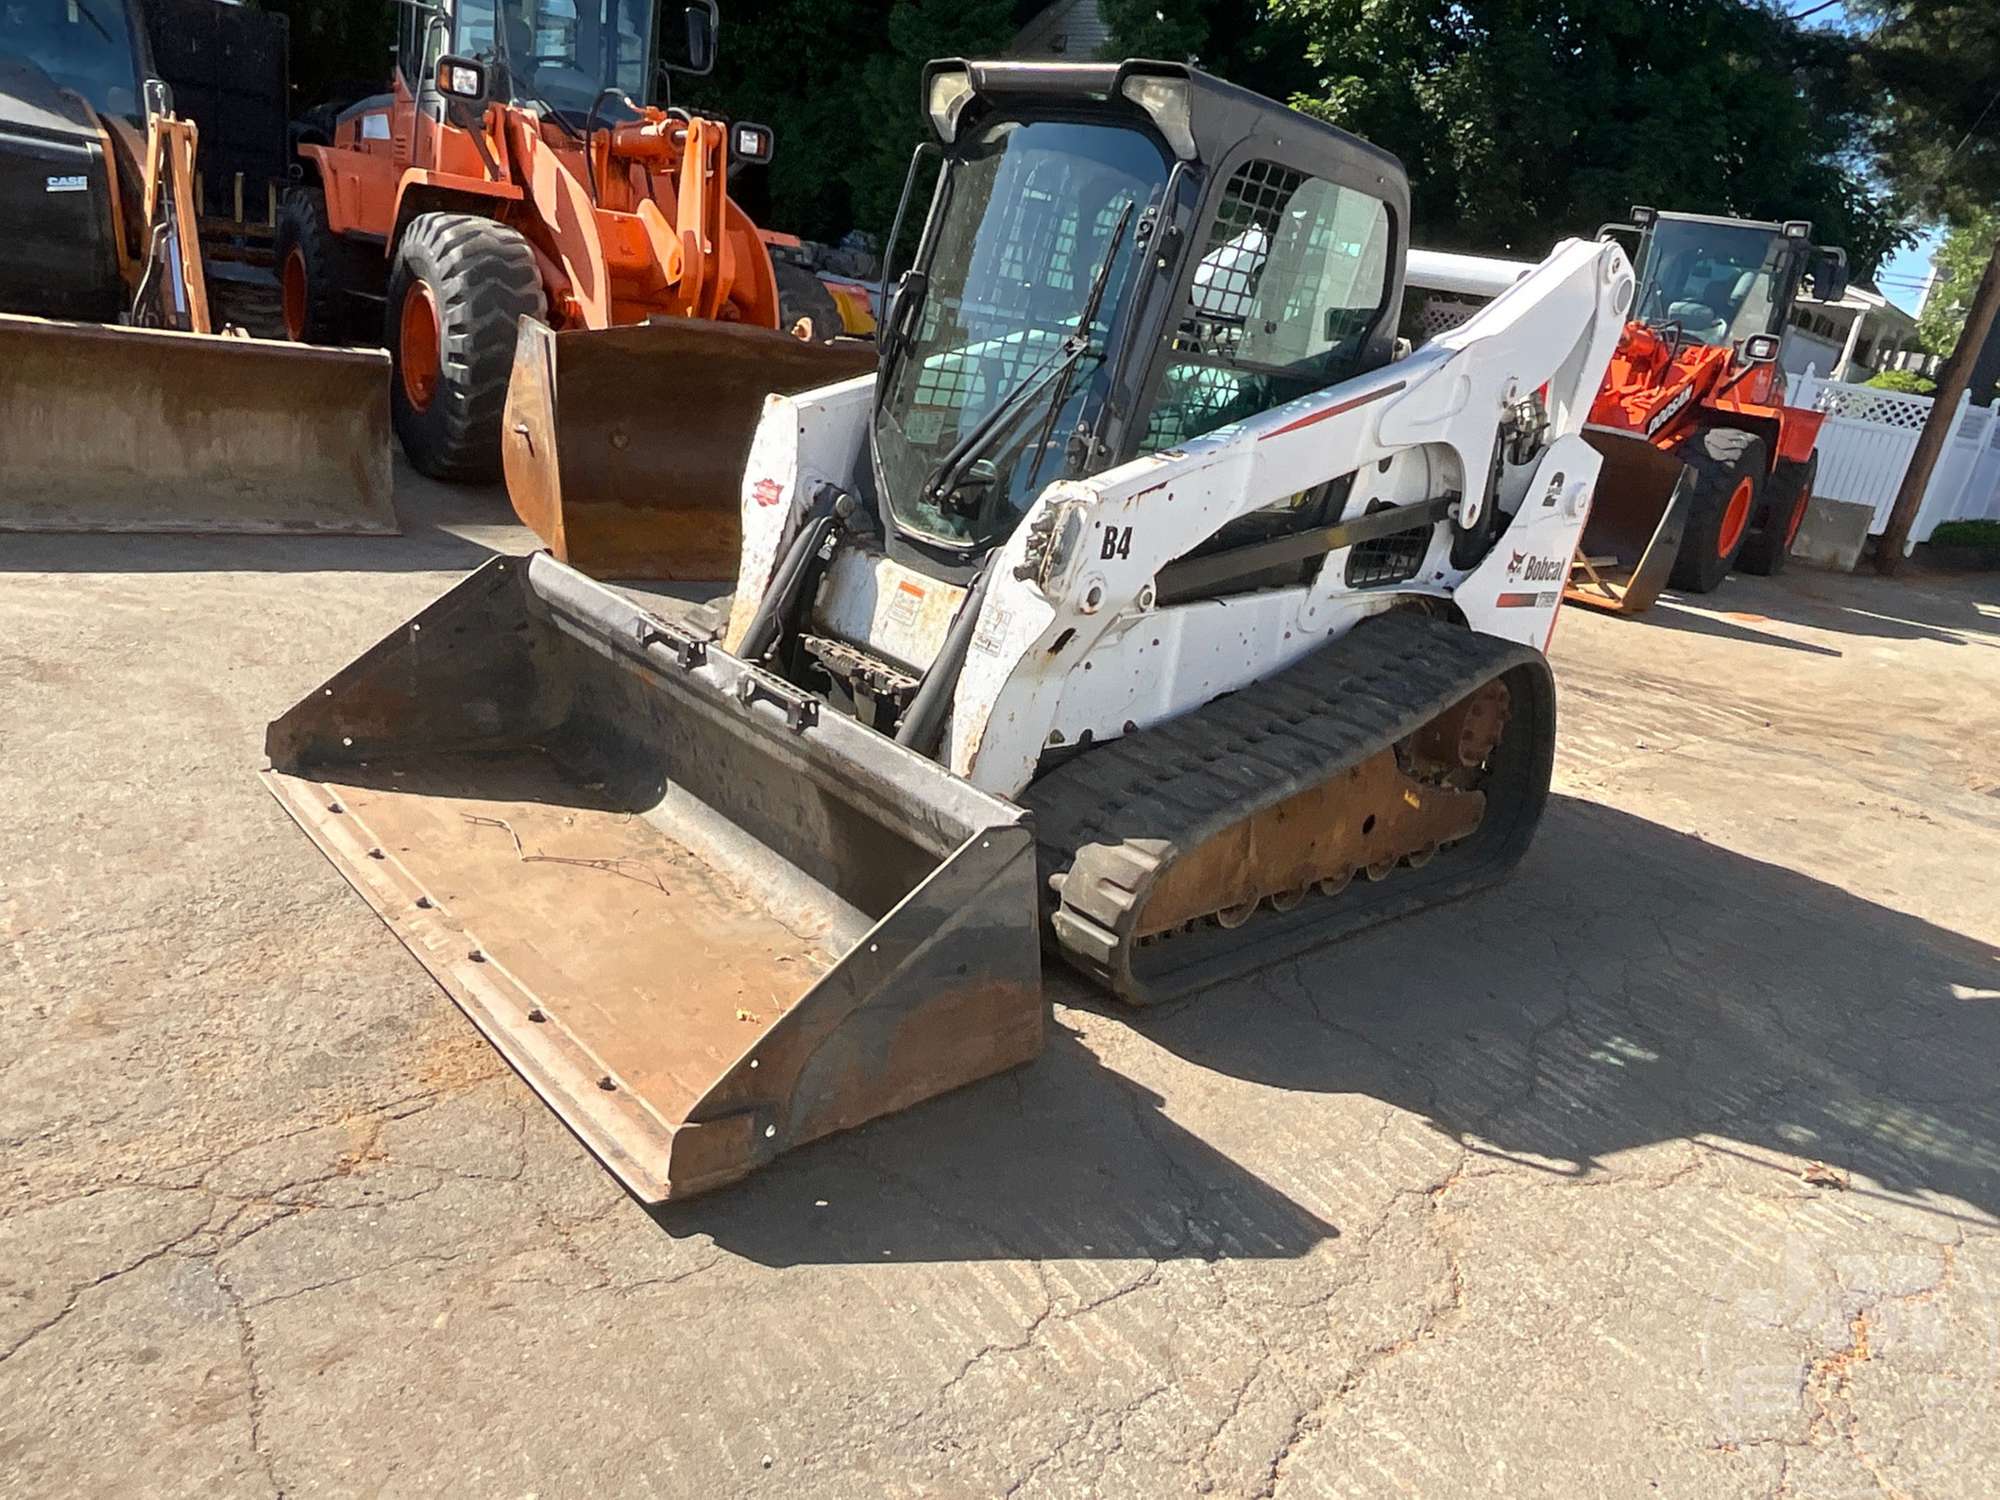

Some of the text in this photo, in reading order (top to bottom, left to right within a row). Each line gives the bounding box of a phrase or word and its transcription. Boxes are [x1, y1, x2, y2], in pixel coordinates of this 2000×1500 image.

[47, 176, 88, 186] CASE
[1100, 525, 1133, 560] B4
[1523, 555, 1566, 581] Bobcat
